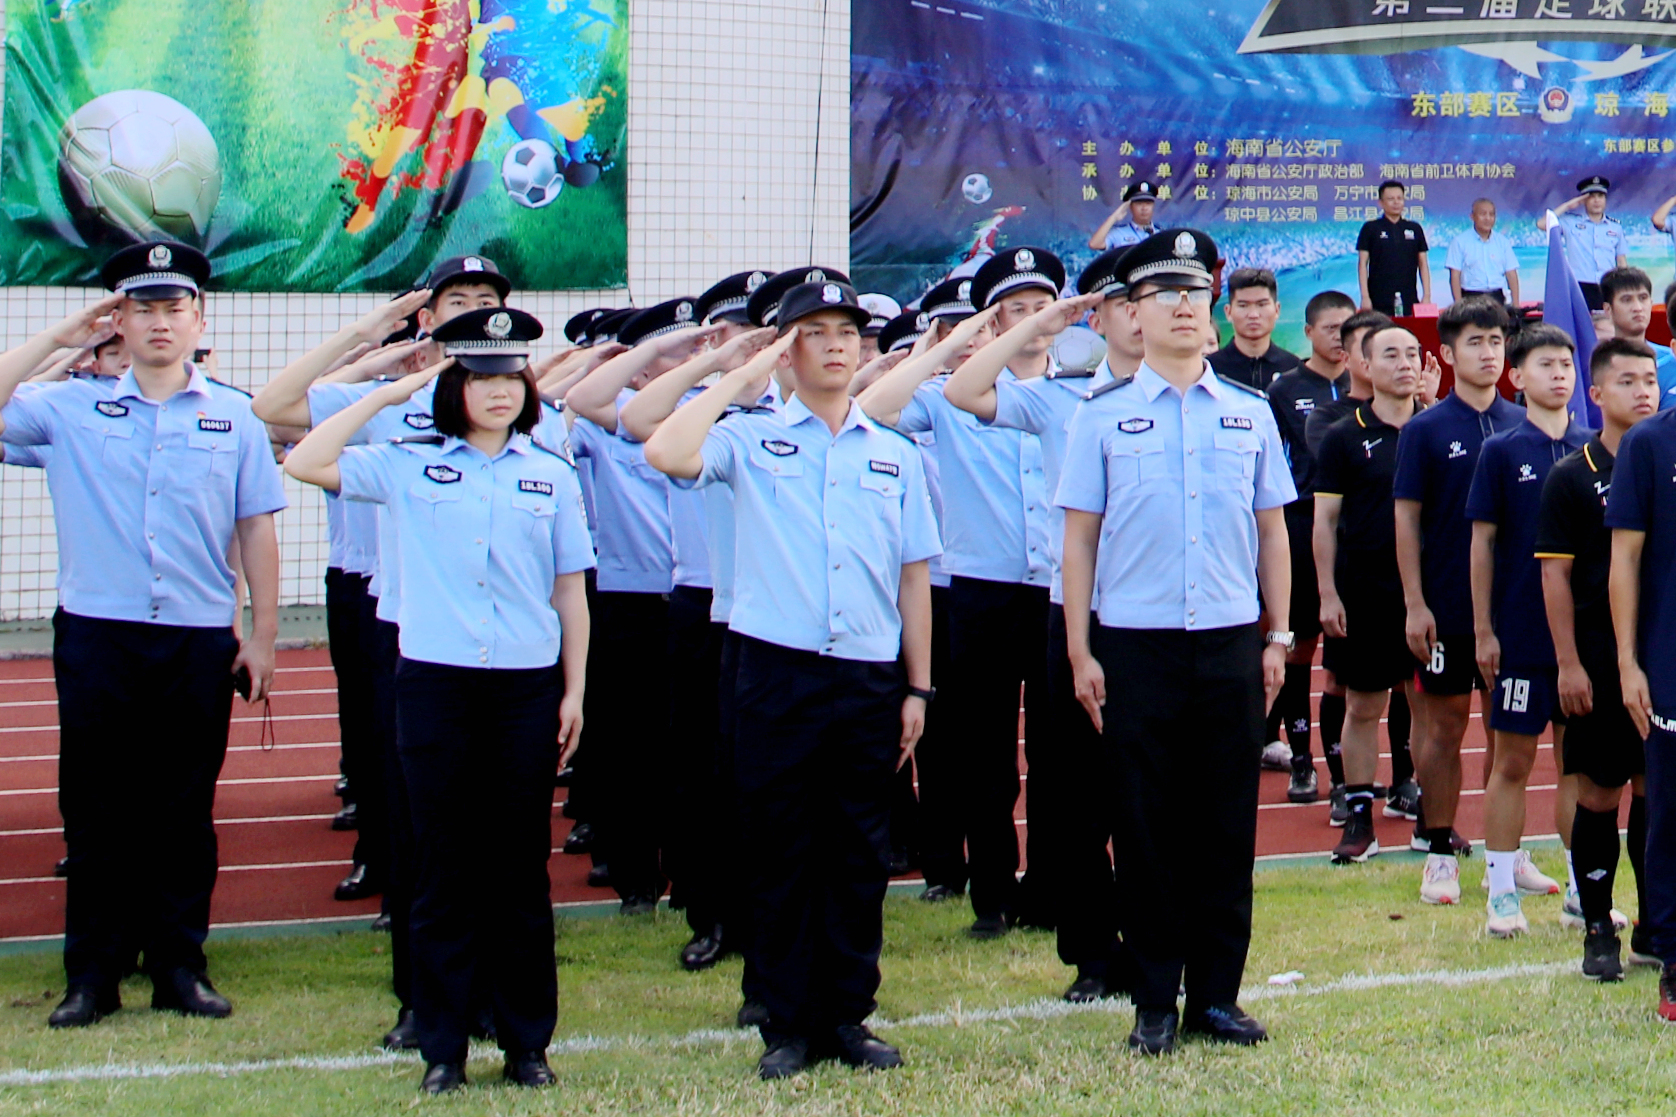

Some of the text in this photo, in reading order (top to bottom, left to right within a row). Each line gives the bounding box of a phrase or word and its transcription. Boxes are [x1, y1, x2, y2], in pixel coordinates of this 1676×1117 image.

[1410, 90, 1670, 119] 东部赛区 琼海
[1224, 137, 1342, 159] 海南省公安厅
[1224, 162, 1365, 180] 海南省公安厅政治部
[1378, 162, 1516, 181] 海南省前卫体育协会
[1081, 184, 1216, 201] 协单位：
[1224, 184, 1319, 202] 琼海市公安局
[1224, 205, 1318, 223] 琼中县公安局
[1501, 677, 1530, 713] 19
